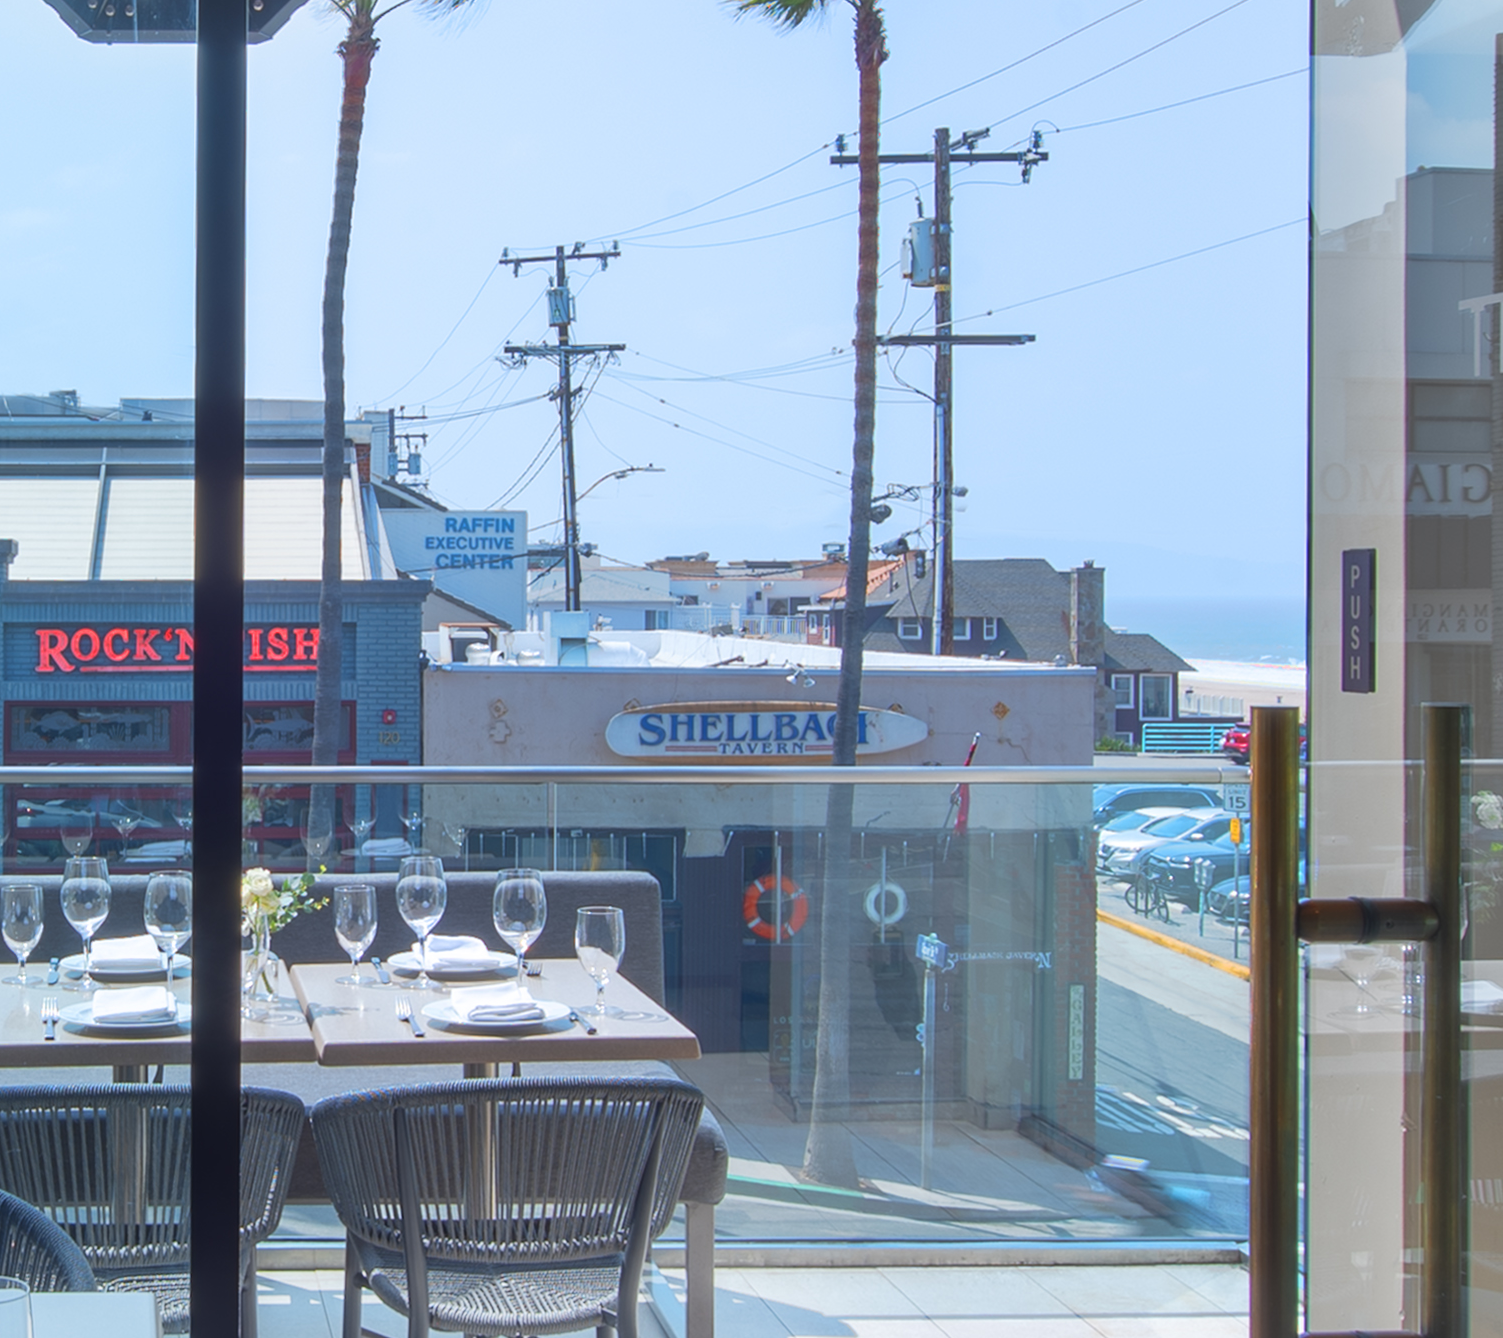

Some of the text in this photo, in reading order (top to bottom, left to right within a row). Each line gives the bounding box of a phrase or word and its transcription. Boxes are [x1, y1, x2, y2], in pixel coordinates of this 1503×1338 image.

[445, 517, 515, 533] RAFFIN
[425, 536, 515, 550] EXECUTIVE
[435, 553, 514, 569] CENTER
[1350, 564, 1362, 681] PUSH
[243, 628, 320, 661] ISH
[378, 731, 400, 745] 120
[718, 742, 805, 755] TAVERN
[1228, 796, 1246, 809] 15
[1072, 999, 1083, 1078] GALLEY
